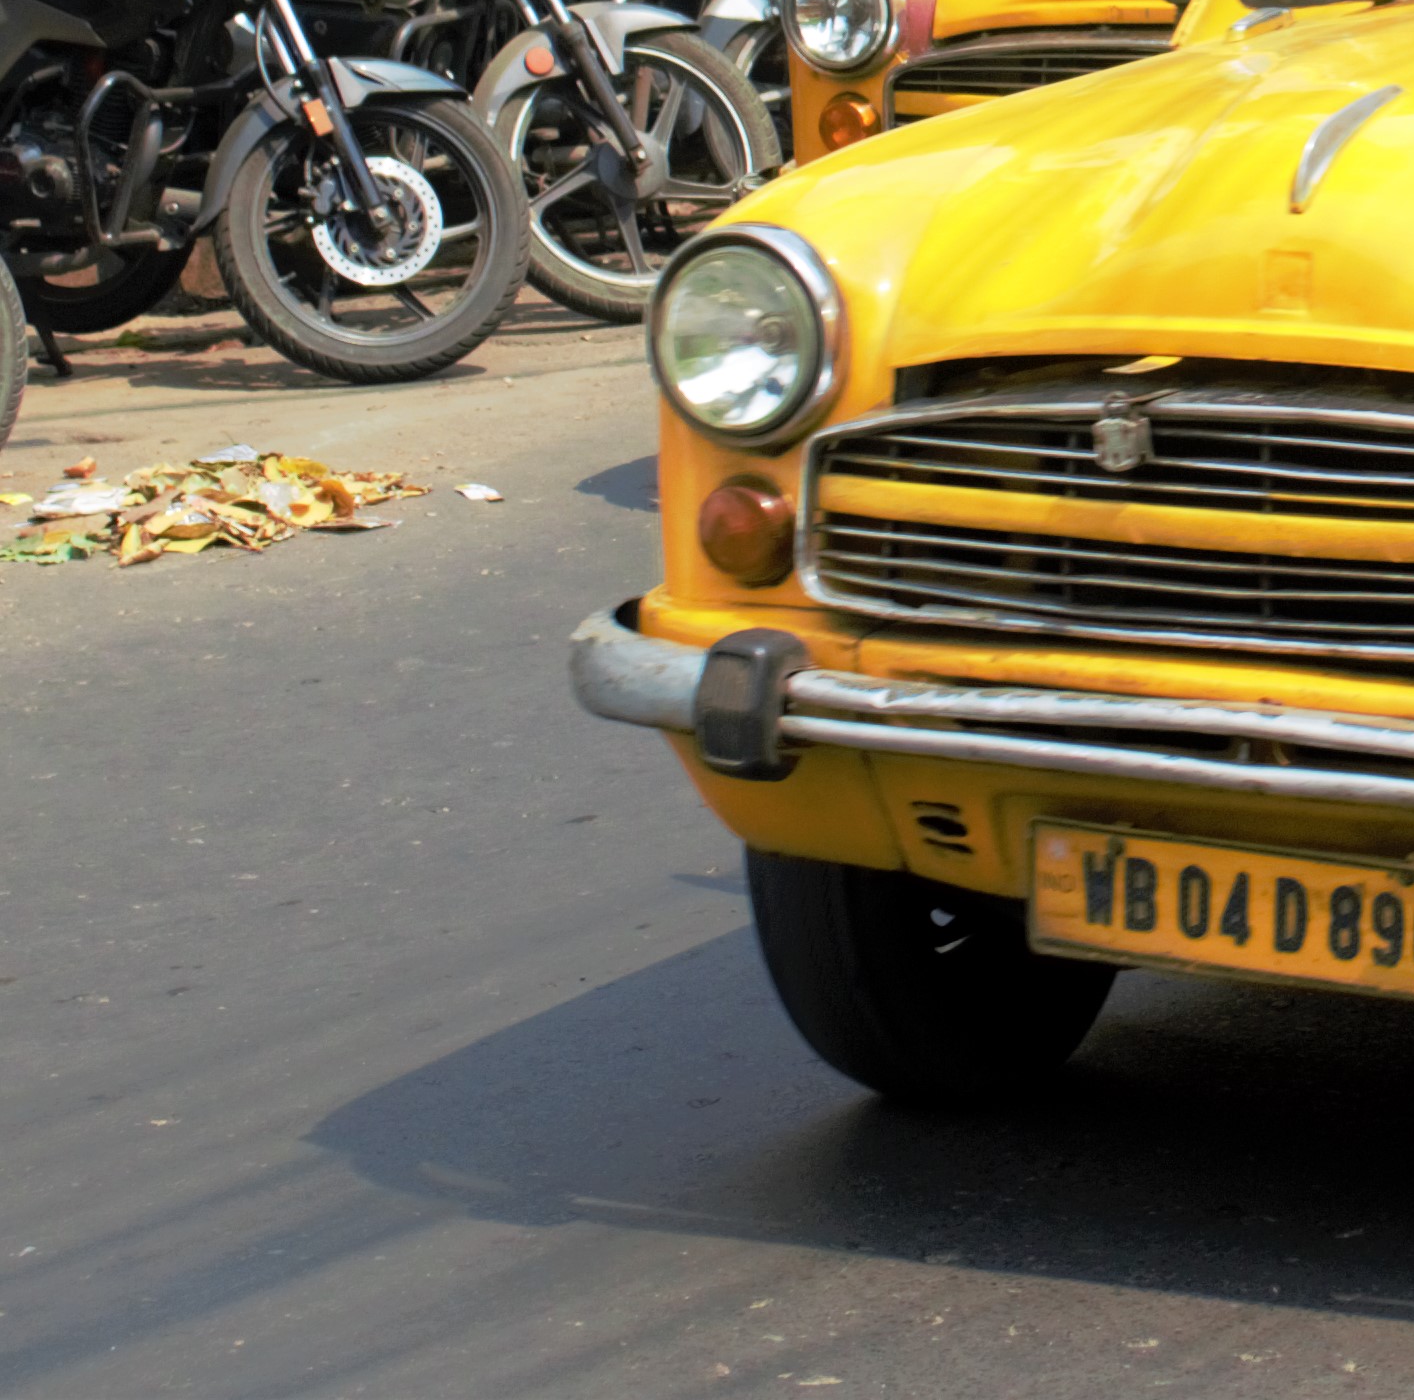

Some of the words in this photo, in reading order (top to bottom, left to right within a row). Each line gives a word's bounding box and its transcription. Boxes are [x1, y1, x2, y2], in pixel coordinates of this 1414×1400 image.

[1082, 851, 1157, 932] WB
[1178, 865, 1250, 946] 04
[1275, 877, 1308, 953] D
